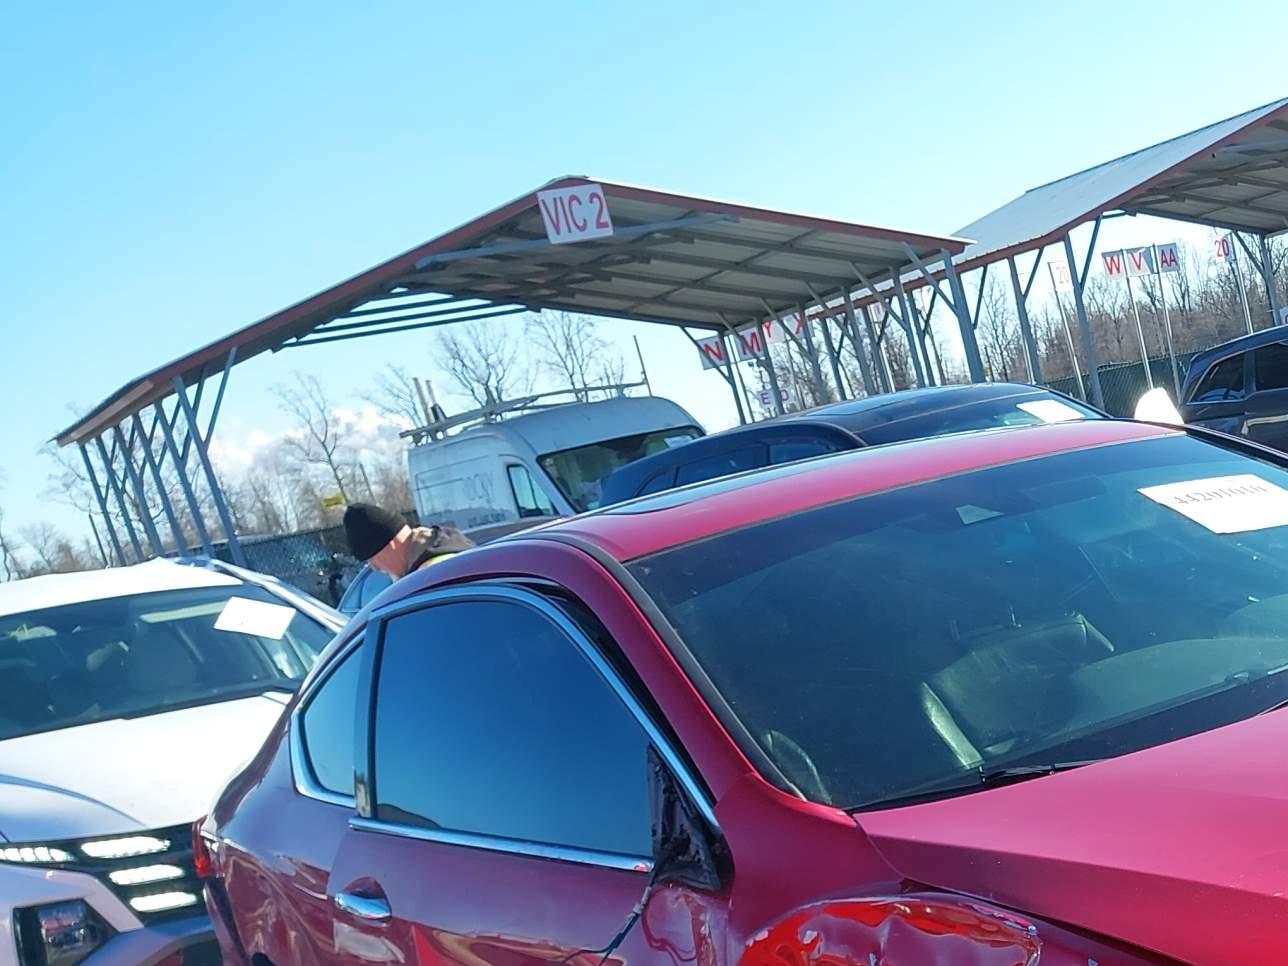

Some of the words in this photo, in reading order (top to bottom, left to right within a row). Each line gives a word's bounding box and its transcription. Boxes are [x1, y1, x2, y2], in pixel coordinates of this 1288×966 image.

[541, 193, 588, 236] VIC
[588, 191, 610, 229] 2
[1160, 247, 1178, 268] AA
[1214, 239, 1230, 257] 20
[1103, 254, 1121, 275] W
[1130, 251, 1142, 270] V
[703, 341, 724, 362] N
[740, 331, 761, 356] M
[761, 391, 771, 405] E
